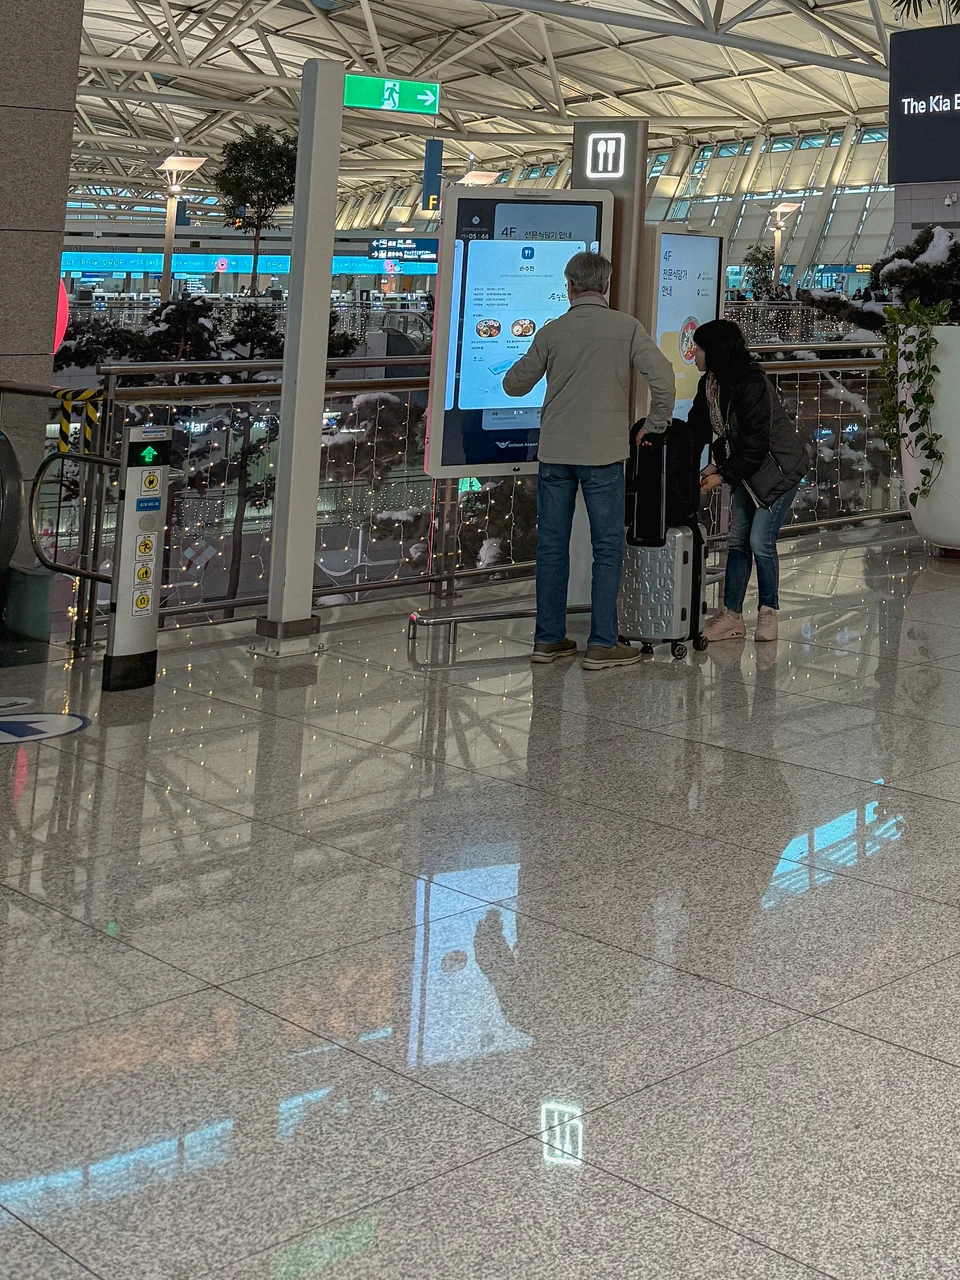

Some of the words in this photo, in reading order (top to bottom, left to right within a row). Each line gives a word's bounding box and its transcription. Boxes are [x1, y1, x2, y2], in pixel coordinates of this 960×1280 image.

[901, 97, 926, 115] The
[929, 94, 951, 113] Kia
[428, 194, 438, 210] F
[501, 226, 517, 238] 4F
[663, 250, 673, 262] 4F
[103, 259, 125, 267] DROP
